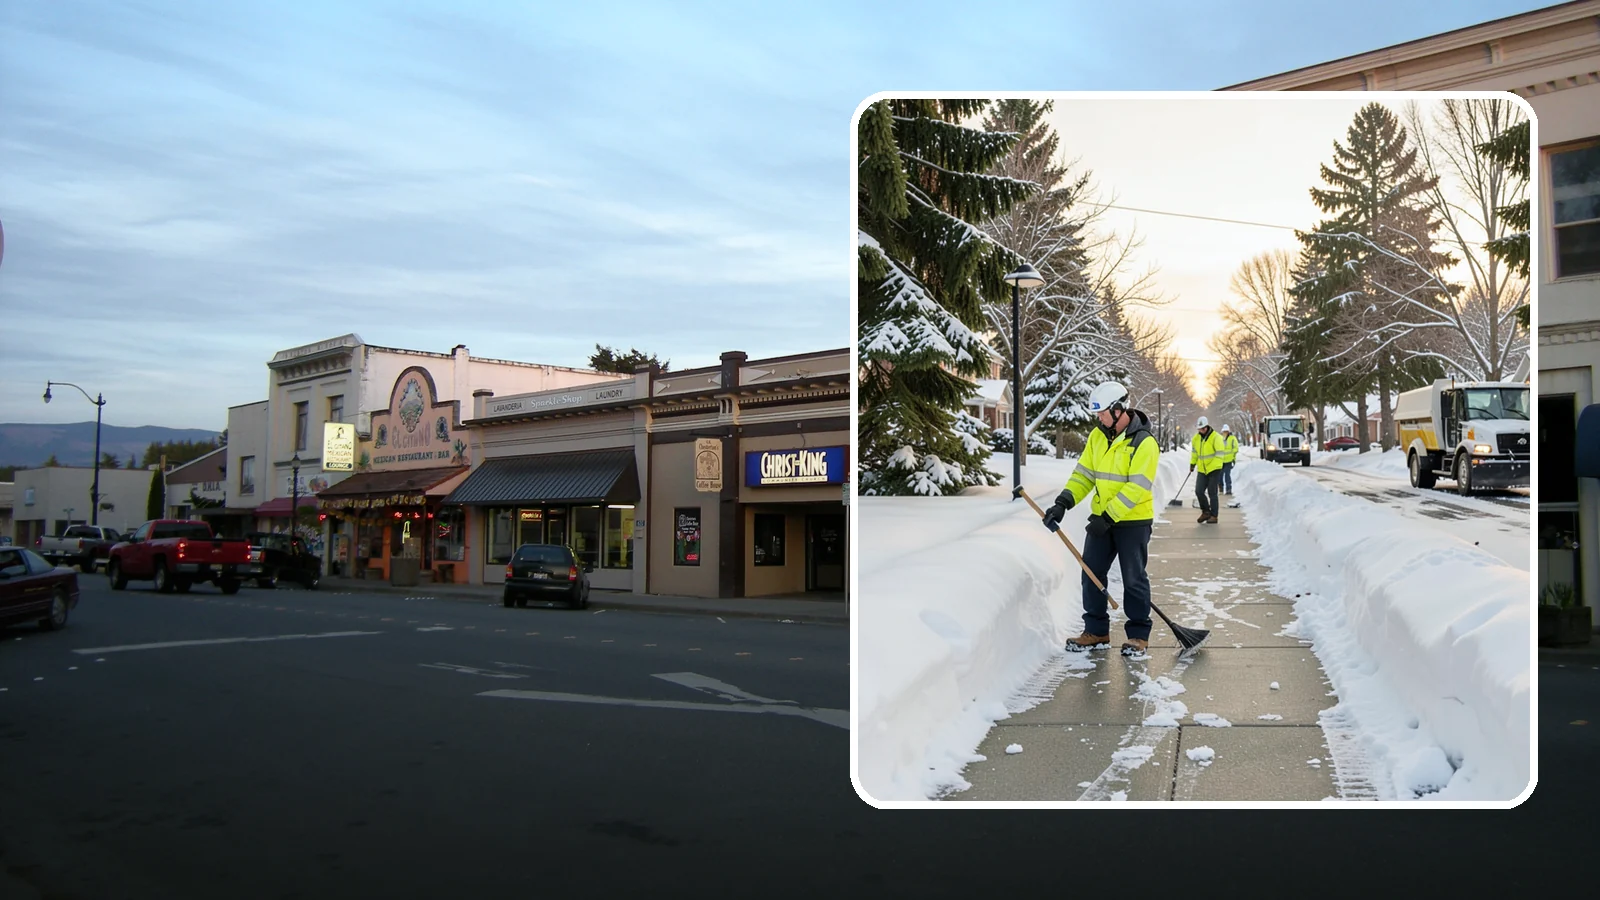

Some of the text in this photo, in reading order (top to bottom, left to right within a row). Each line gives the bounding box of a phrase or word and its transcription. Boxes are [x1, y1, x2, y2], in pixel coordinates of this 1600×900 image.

[596, 389, 623, 399] LAUNDRY
[562, 395, 582, 404] Shop
[494, 402, 522, 412] LAVANDERIA
[374, 450, 450, 464] MEXICAN RESTAURANT BAR
[761, 450, 827, 478] CHRIST KING
